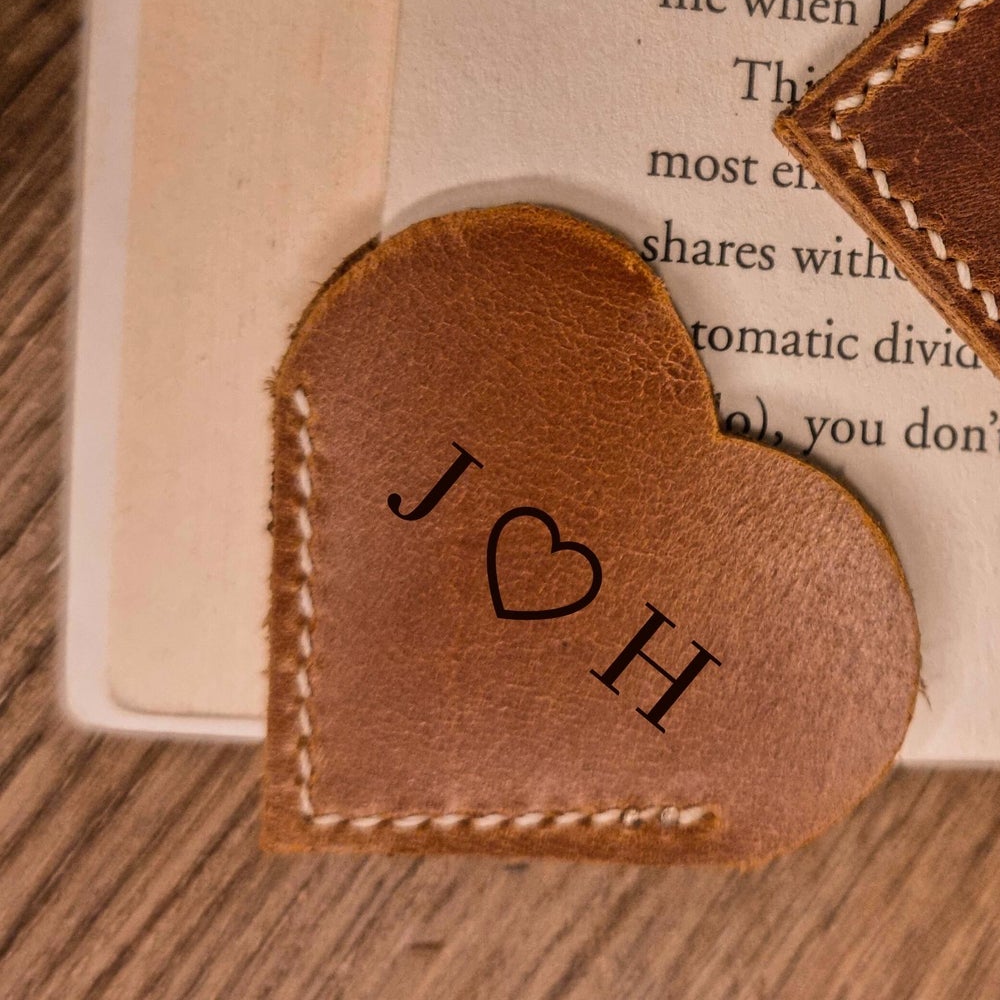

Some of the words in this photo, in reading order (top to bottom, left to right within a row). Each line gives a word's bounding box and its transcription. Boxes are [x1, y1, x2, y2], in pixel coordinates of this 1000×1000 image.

[732, 55, 820, 107] Thi
[646, 145, 758, 186] most
[640, 219, 777, 272] shares
[691, 317, 860, 362] tomatic
[873, 320, 982, 371] divid
[714, 393, 784, 448] o),
[802, 414, 886, 456] you
[387, 441, 484, 521] J
[589, 601, 722, 734] H
